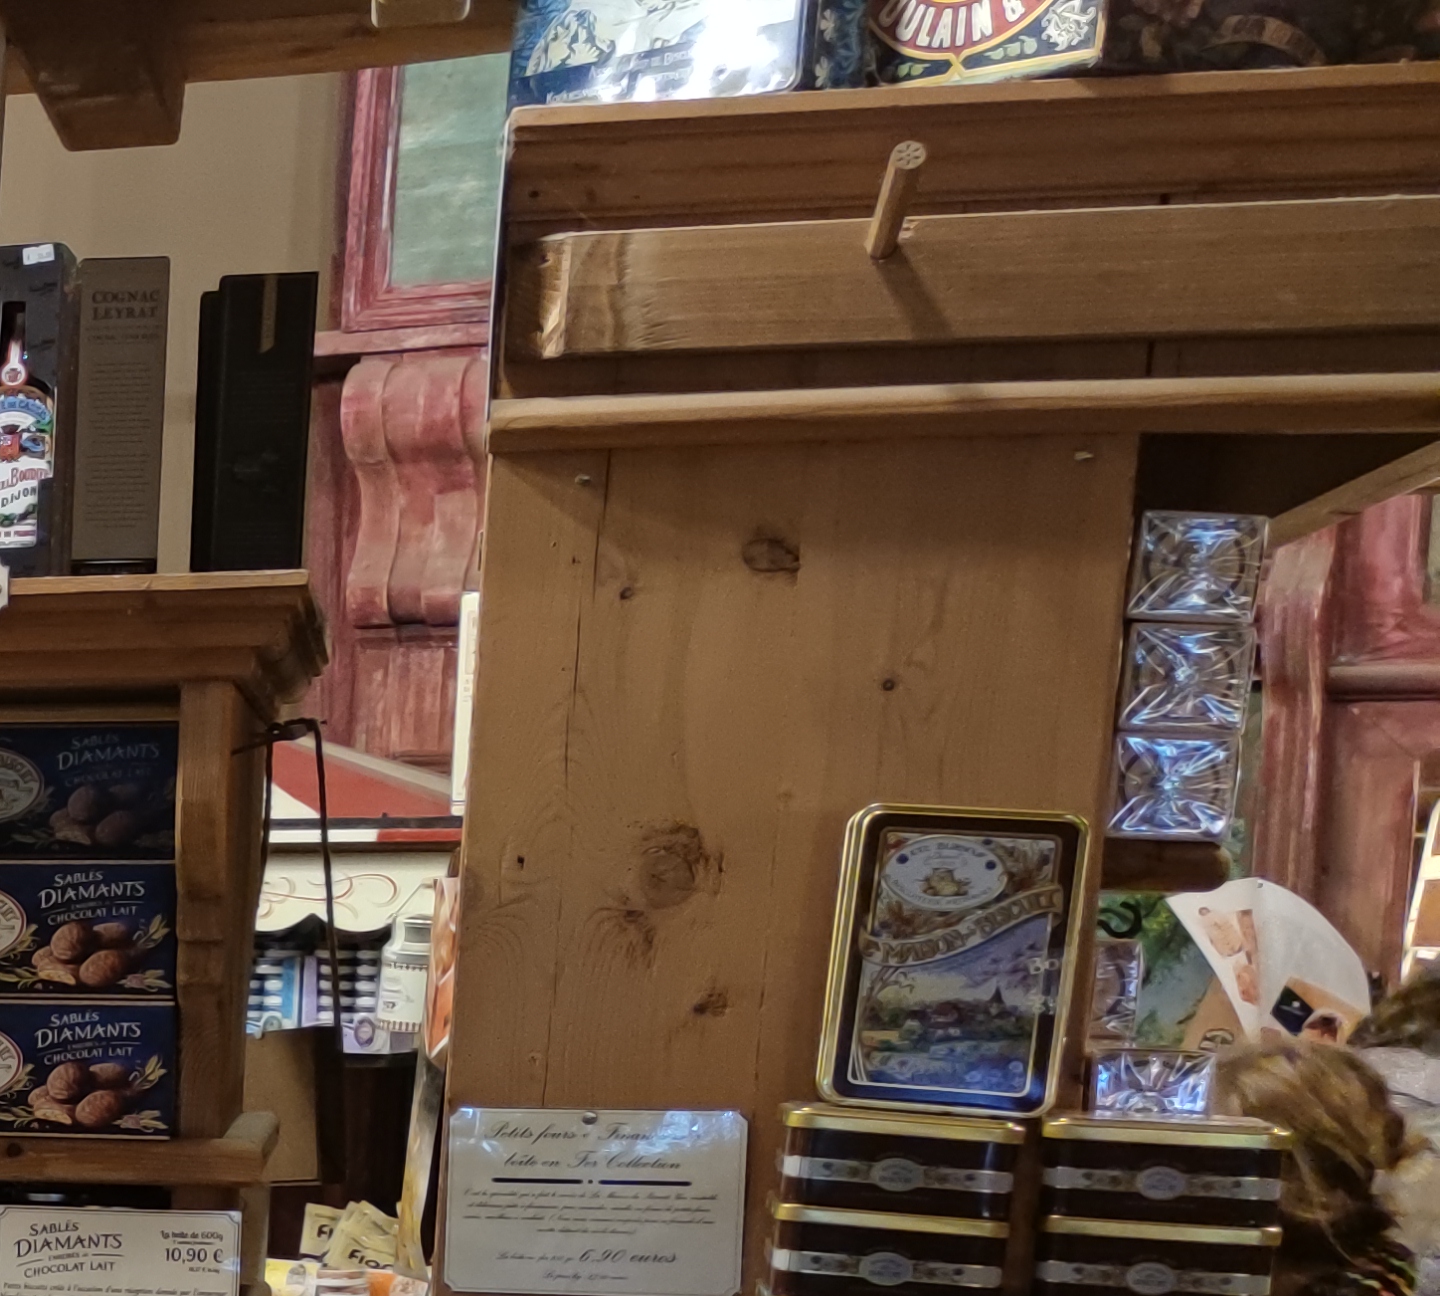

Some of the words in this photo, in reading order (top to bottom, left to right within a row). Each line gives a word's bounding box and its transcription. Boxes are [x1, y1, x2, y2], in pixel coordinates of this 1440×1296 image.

[92, 290, 159, 303] COGNAC
[1, 486, 37, 508] DIJON
[56, 742, 161, 771] DIAMANTS
[53, 868, 104, 886] SABLÉS
[37, 880, 146, 909] DIAMANTS
[46, 906, 108, 926] CHOCOLAT
[111, 902, 138, 917] LAIT
[165, 1247, 208, 1265] 10,90
[213, 1248, 224, 1264] €
